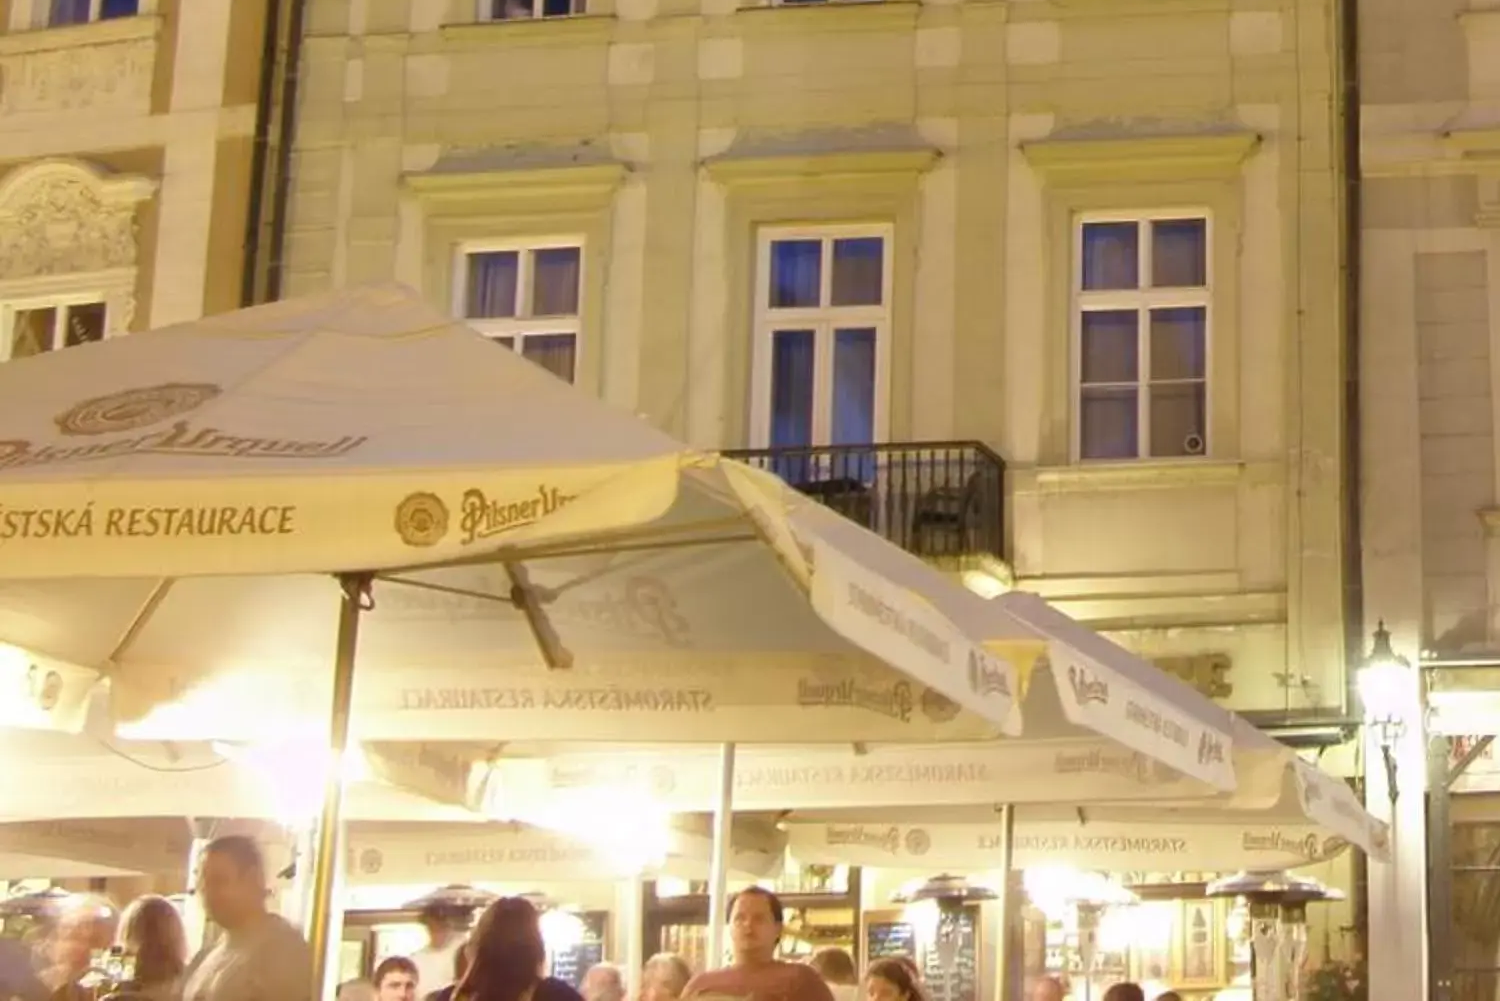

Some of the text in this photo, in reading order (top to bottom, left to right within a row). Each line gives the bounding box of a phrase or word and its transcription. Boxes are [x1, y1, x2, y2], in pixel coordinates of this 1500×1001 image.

[152, 419, 368, 459] Urquell
[0, 501, 297, 539] STSKÁ RESTAURACE
[460, 488, 541, 545] Pilsner
